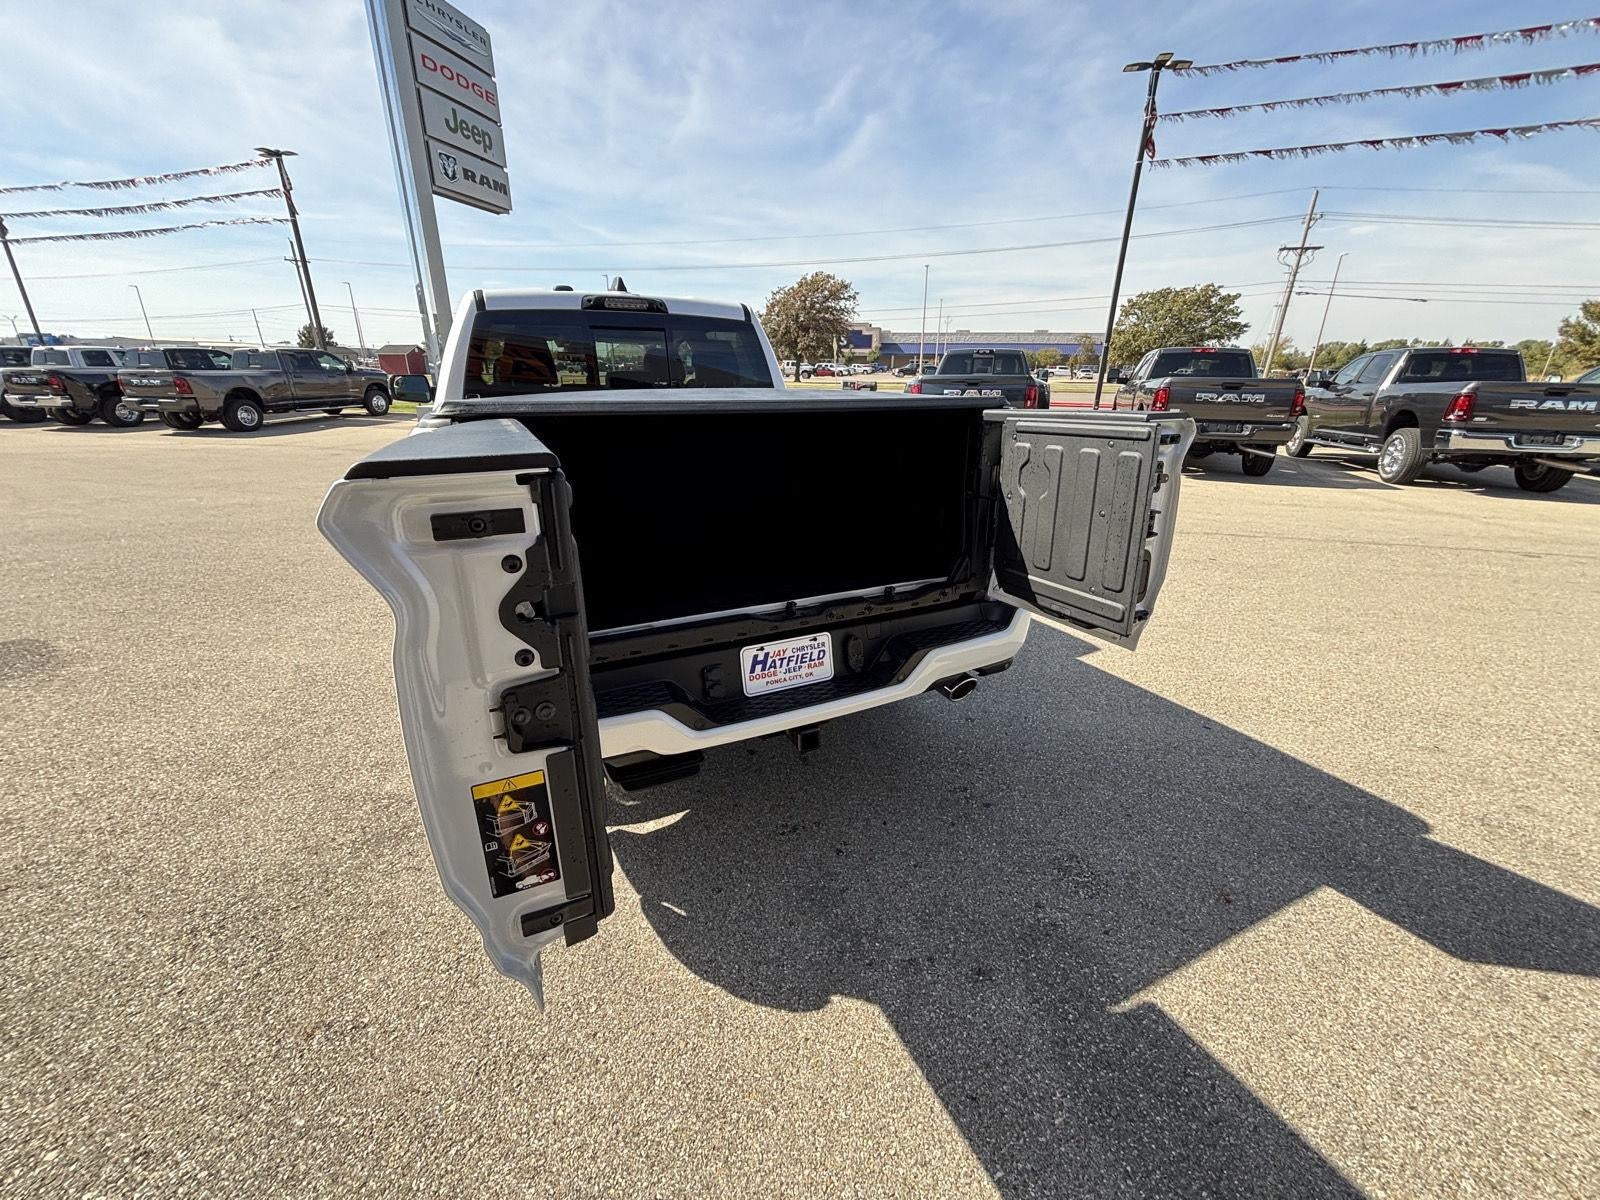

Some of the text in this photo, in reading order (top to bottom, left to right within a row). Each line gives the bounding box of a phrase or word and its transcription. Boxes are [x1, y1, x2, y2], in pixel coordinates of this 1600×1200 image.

[421, 53, 496, 106] DODGE
[444, 107, 493, 153] Jeep
[462, 167, 508, 196] RAM
[1195, 392, 1265, 403] RAM
[1509, 399, 1598, 411] RAM
[770, 641, 826, 659] JAY CHRYSLER
[749, 649, 826, 675] HATFIELD
[749, 660, 825, 682] DODGE JEEP RAM
[765, 671, 814, 686] PONCA CITY, OK
